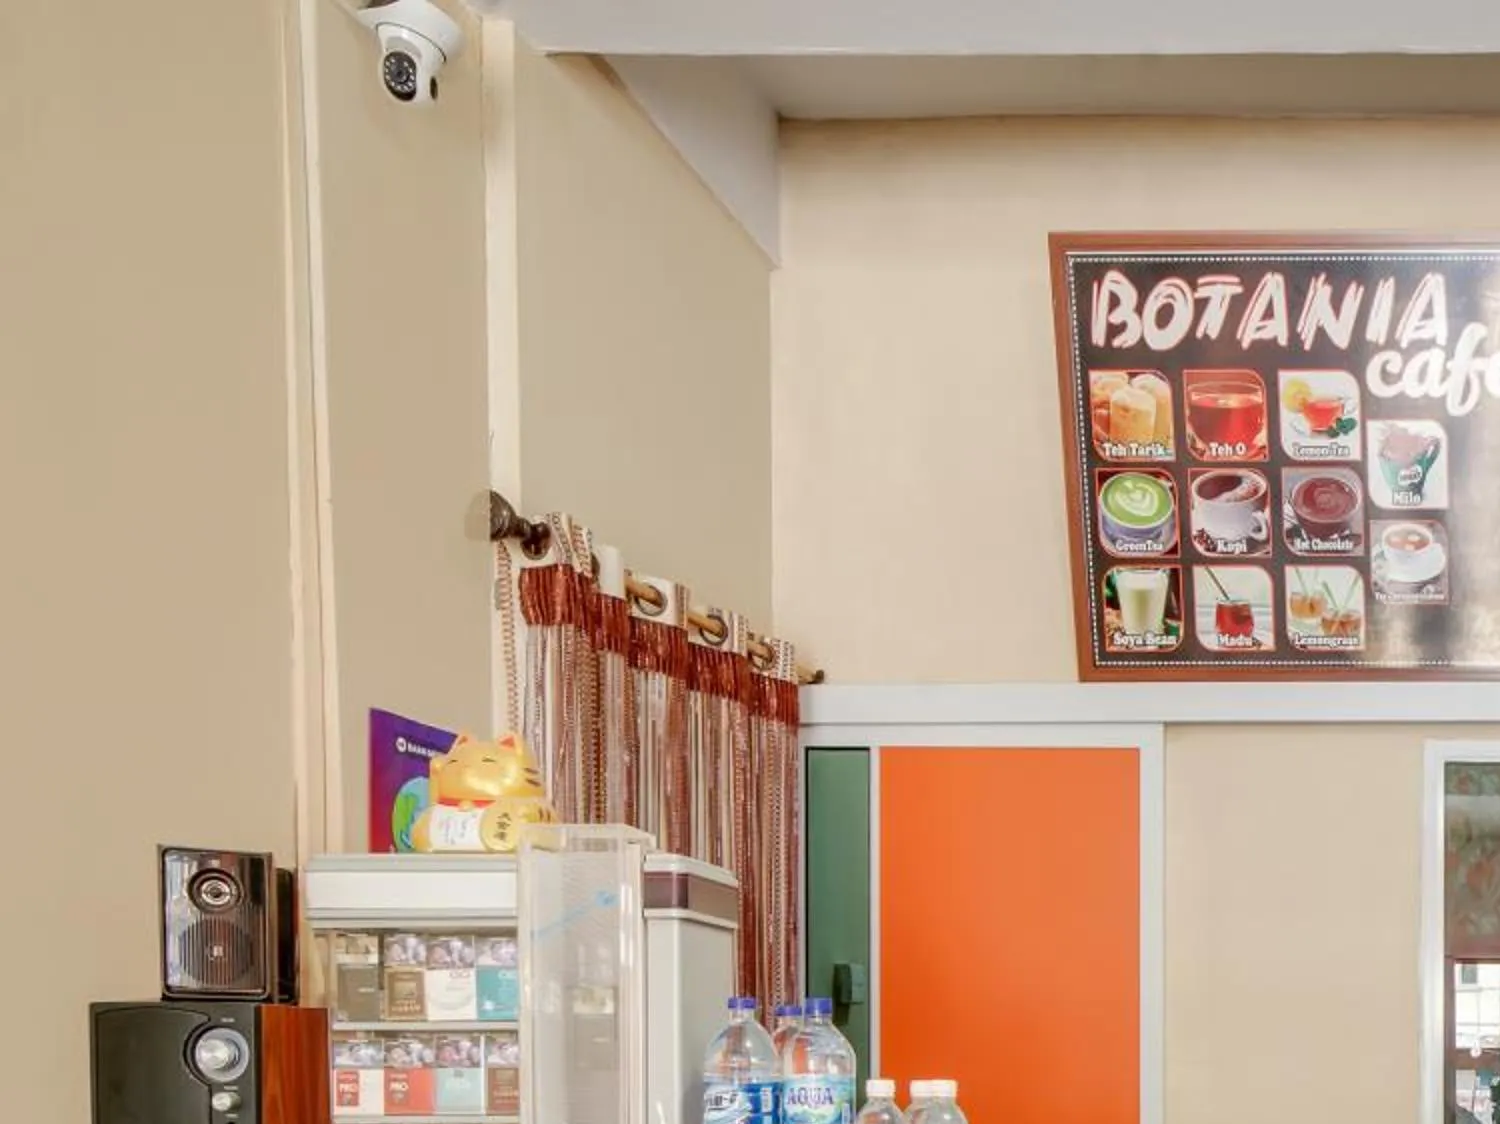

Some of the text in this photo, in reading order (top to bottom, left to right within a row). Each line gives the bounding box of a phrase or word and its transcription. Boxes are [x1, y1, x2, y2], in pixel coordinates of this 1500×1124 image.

[1089, 270, 1449, 351] BOTANIA
[1102, 441, 1128, 457] Teh
[1209, 441, 1247, 457] Teh O
[1392, 488, 1422, 506] Milo
[1216, 538, 1248, 556] Kopi
[1113, 631, 1144, 649] Soya
[787, 1086, 834, 1106] AQUA
